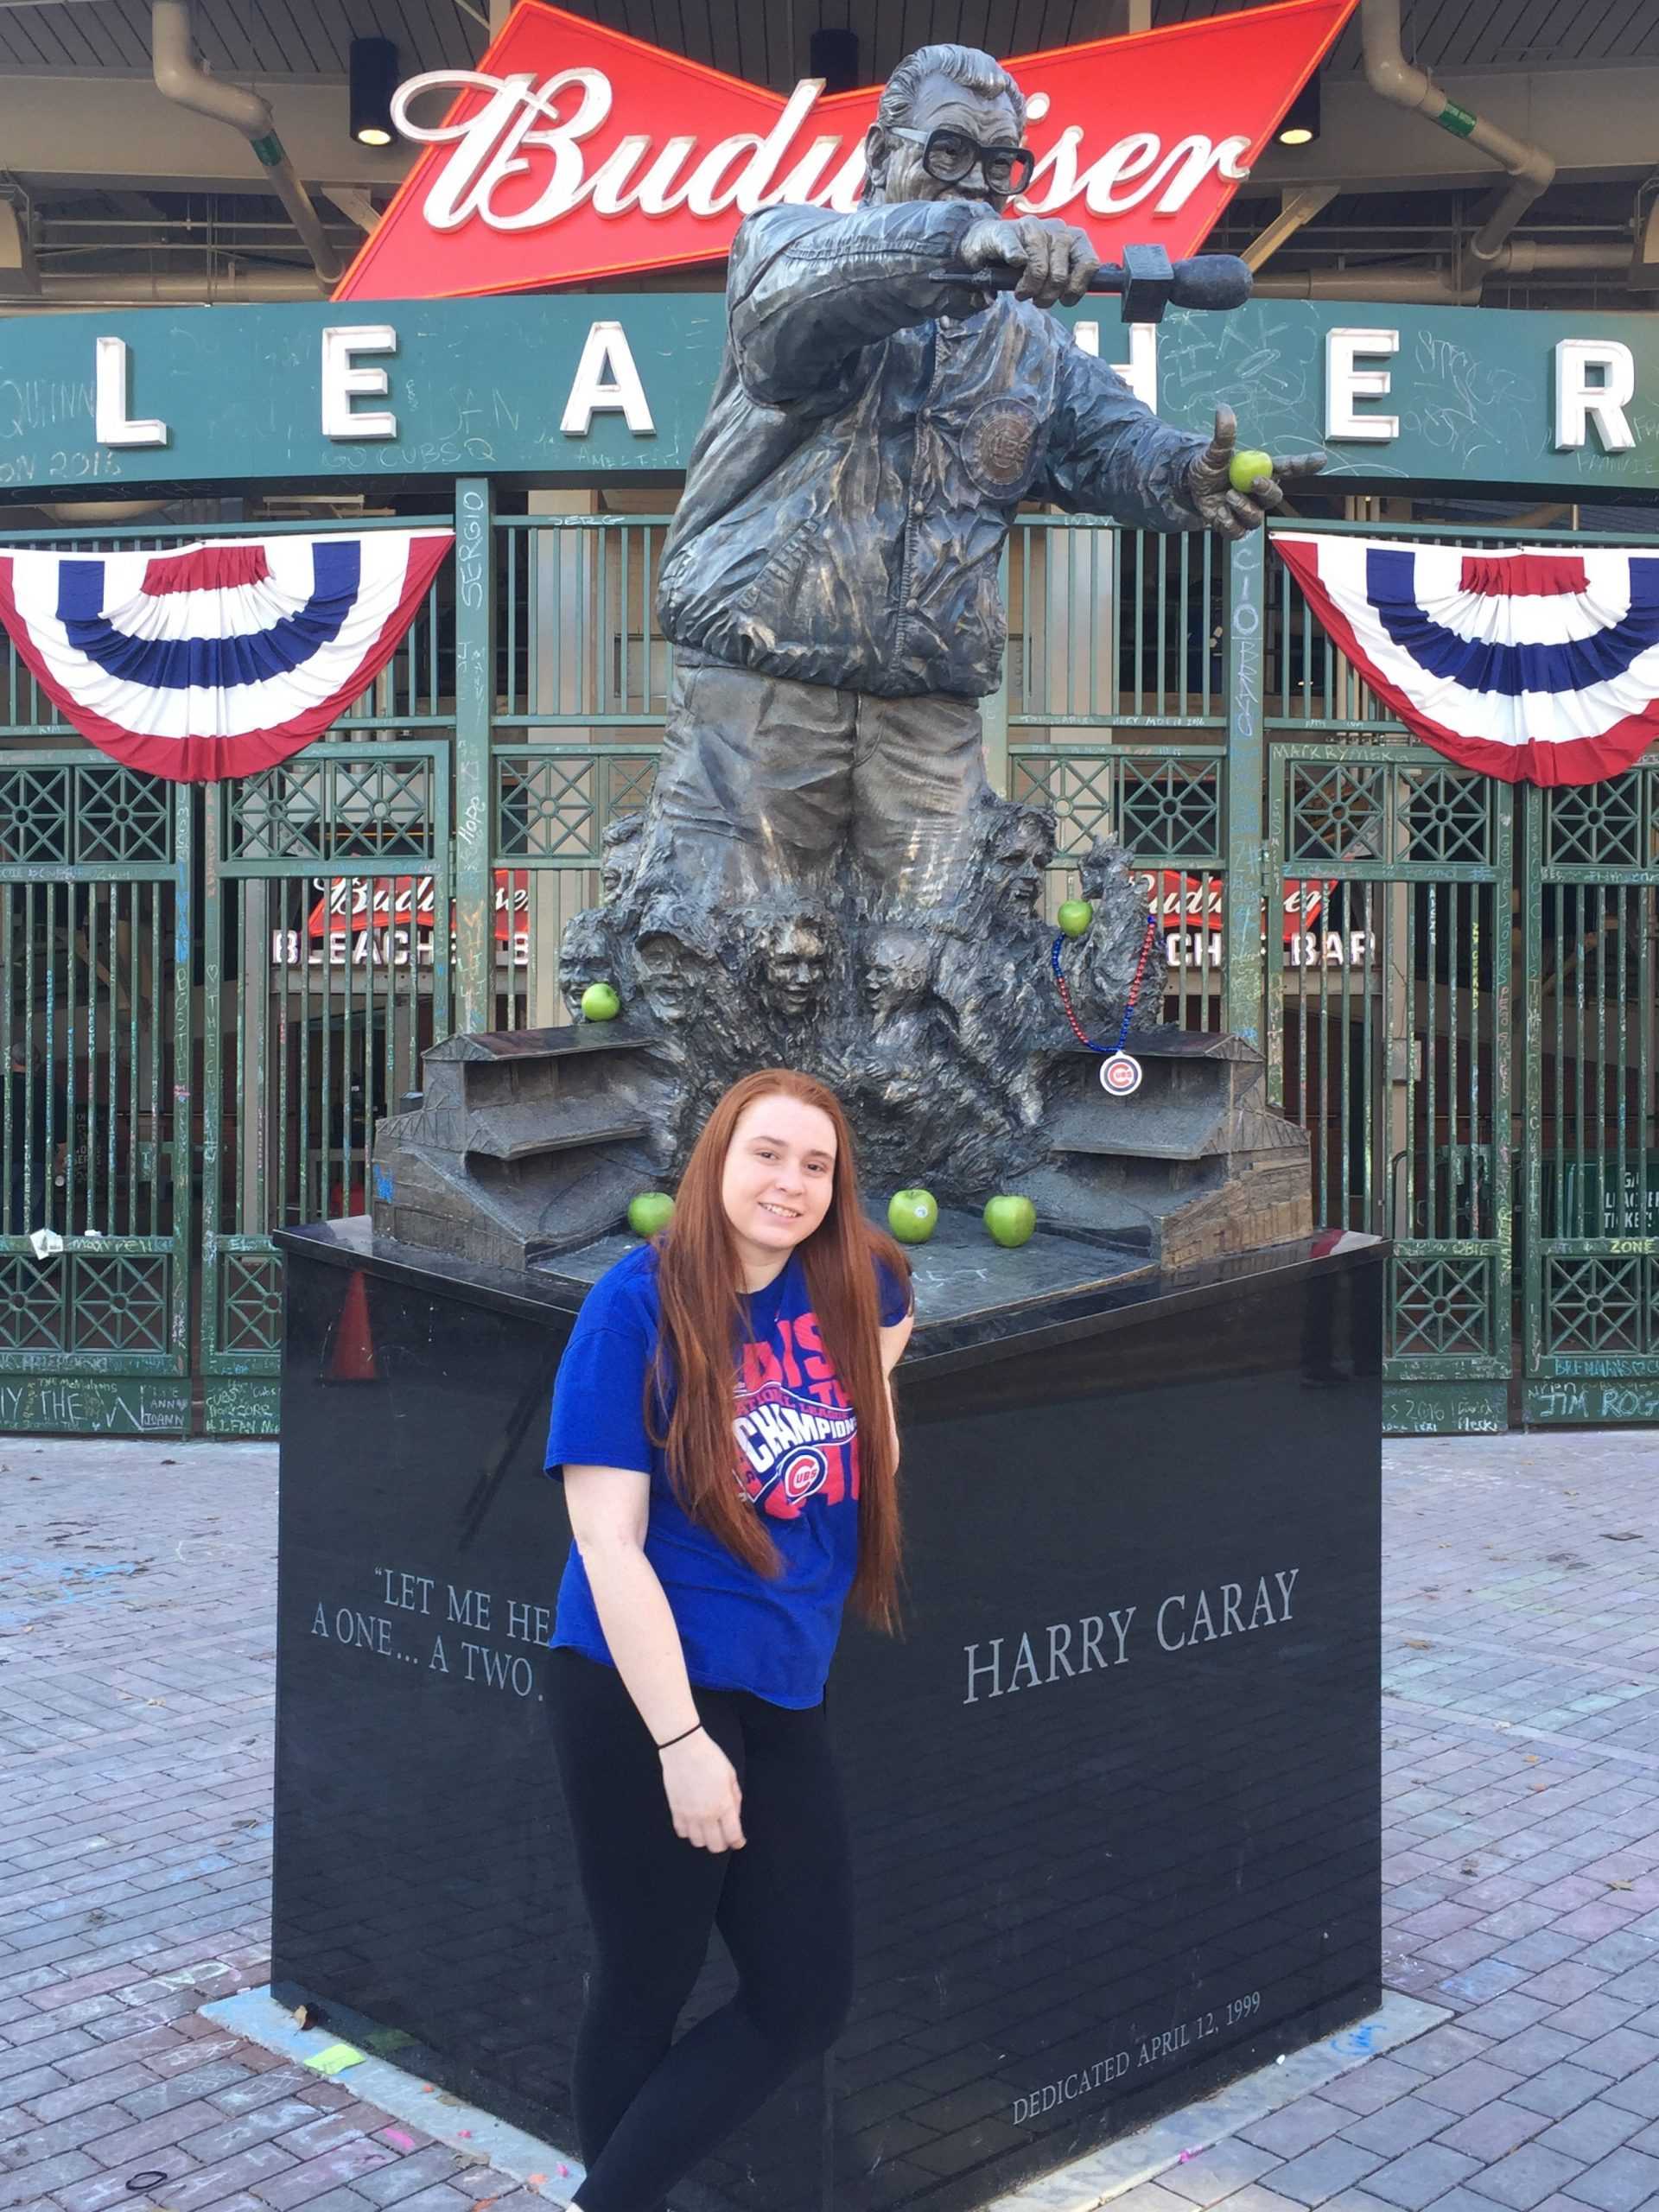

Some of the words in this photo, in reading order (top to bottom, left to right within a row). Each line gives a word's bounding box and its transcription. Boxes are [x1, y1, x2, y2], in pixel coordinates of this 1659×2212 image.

[390, 68, 1250, 233] Budwser
[96, 321, 1636, 452] LEAHER
[272, 930, 457, 964] BEACH
[311, 1601, 329, 1637] A
[429, 1635, 449, 1673] A
[447, 1584, 491, 1630] ME
[506, 1599, 550, 1647] HE
[963, 1606, 1137, 1705] HARRY
[1156, 1568, 1300, 1652] CARAY
[1013, 2051, 1130, 2126] DEDICATED
[1136, 2024, 1190, 2067] APRIL
[1196, 2012, 1219, 2039] 12,
[1226, 1991, 1261, 2025] 1999
